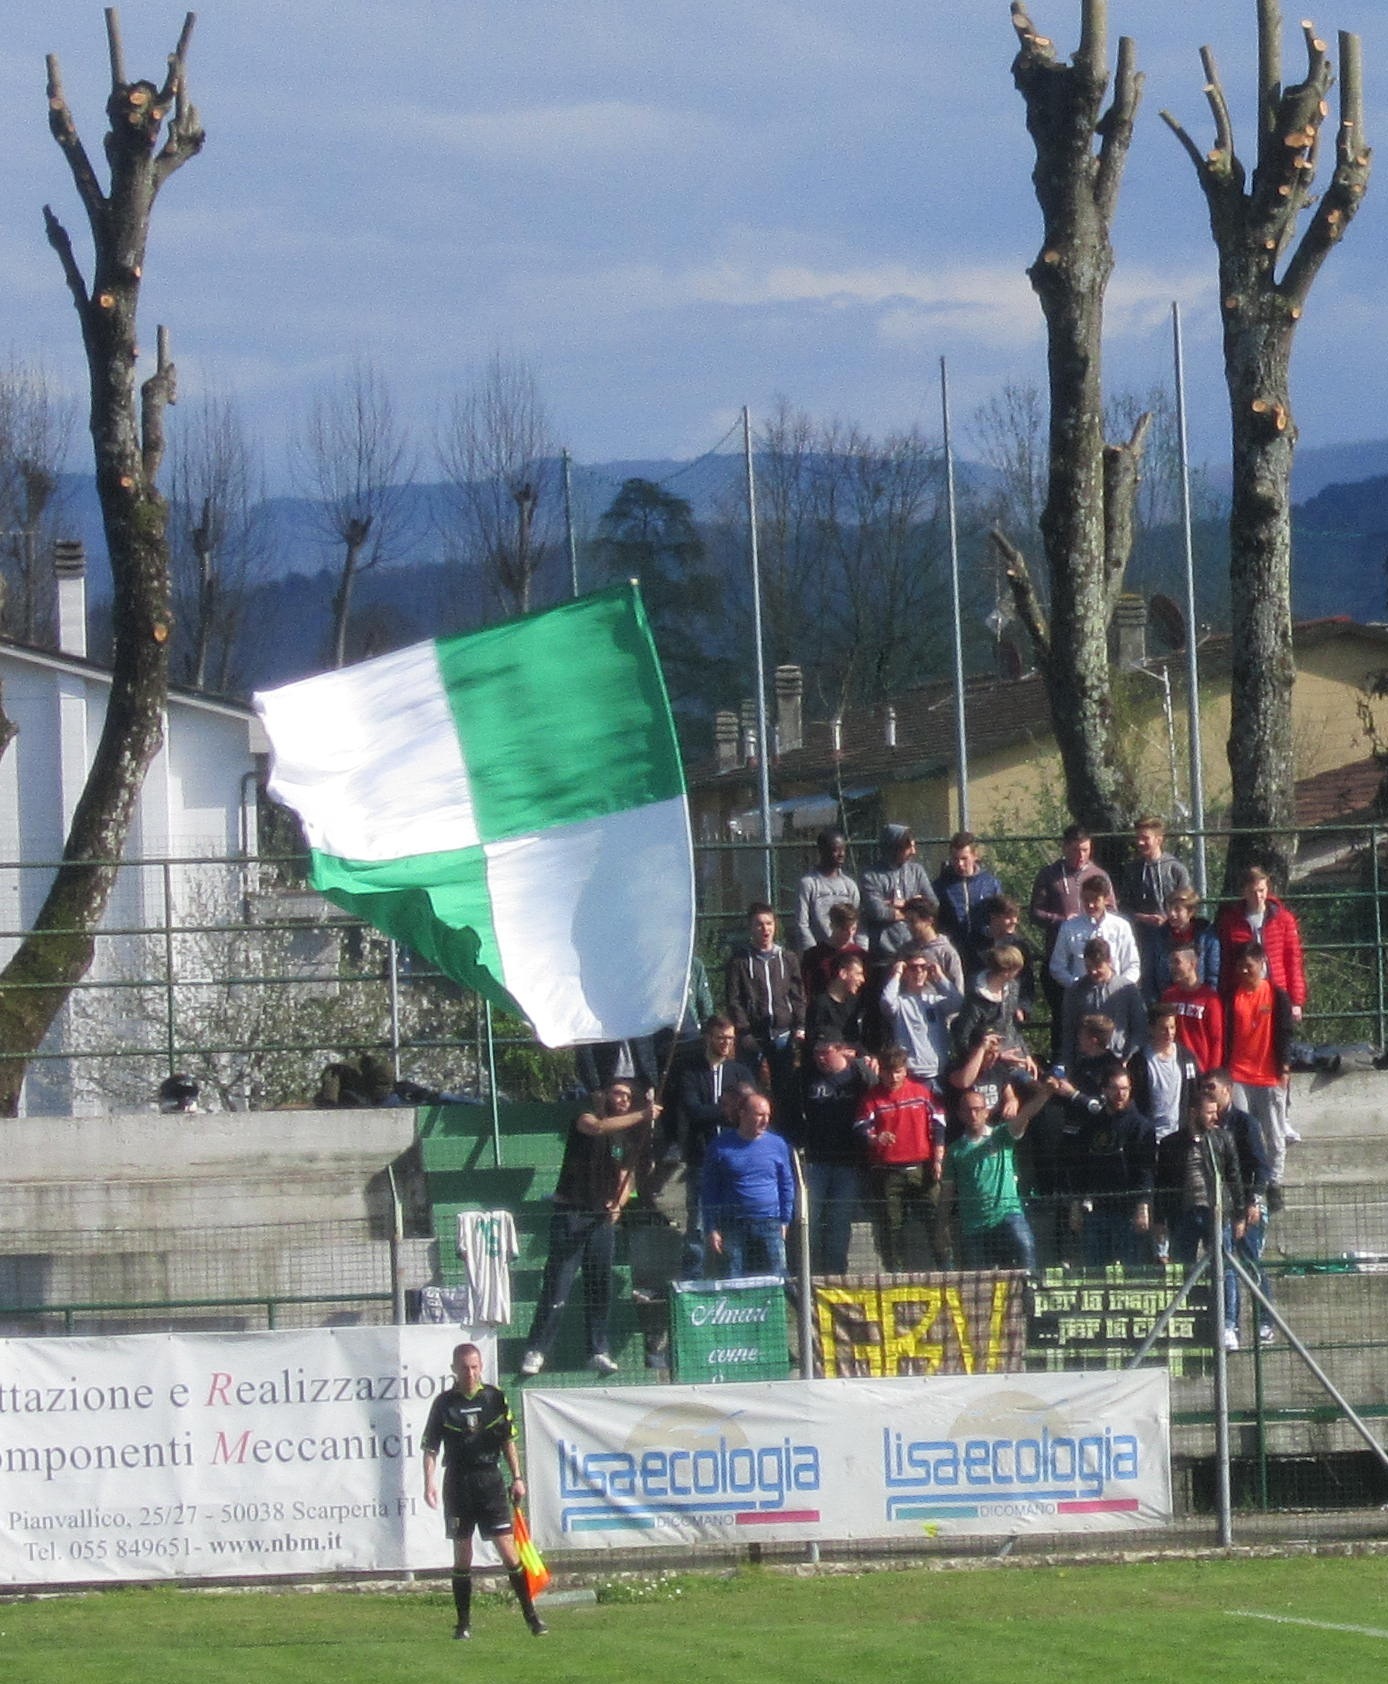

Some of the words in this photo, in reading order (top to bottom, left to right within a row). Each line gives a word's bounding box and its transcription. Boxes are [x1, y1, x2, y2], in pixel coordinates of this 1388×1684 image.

[1033, 1290, 1076, 1317] per
[1080, 1290, 1103, 1311] la
[1106, 1317, 1129, 1338] la
[169, 1383, 189, 1407] e
[204, 1364, 458, 1406] Realizzazion
[0, 1431, 193, 1481] mponenti
[210, 1423, 416, 1465] Meccanici
[8, 1507, 132, 1531] Pianvallico,
[139, 1504, 198, 1527] 25/27
[220, 1502, 285, 1523] 50038
[292, 1498, 389, 1523] Scarperia
[656, 1513, 735, 1529] DICOMANO
[979, 1502, 1056, 1517] DICOMANO
[24, 1541, 62, 1562] Tel.
[69, 1539, 108, 1561] 055
[209, 1531, 343, 1555] www.nbm.it
